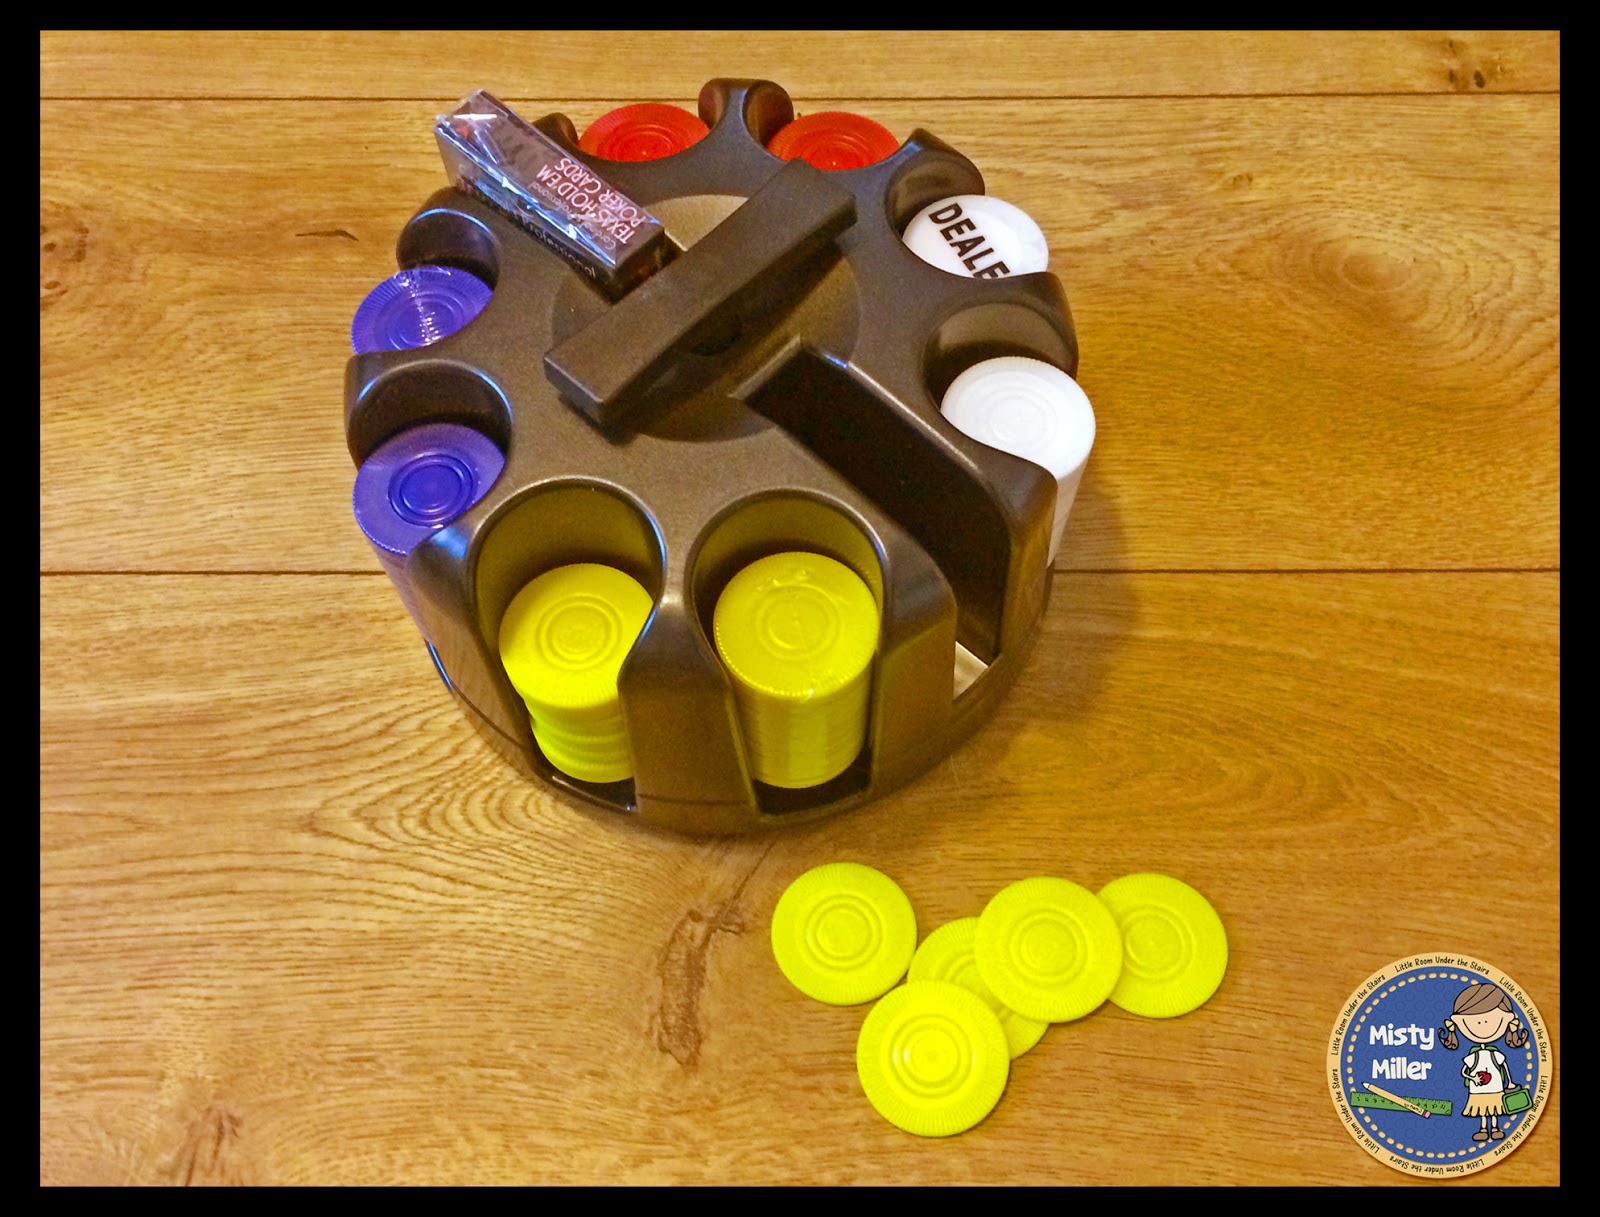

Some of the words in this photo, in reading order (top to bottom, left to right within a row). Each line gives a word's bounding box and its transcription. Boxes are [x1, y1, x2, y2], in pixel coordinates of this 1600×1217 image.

[536, 164, 599, 213] HOLD'EM
[554, 157, 602, 193] CARDS
[598, 188, 647, 228] POKER
[598, 208, 635, 244] TEXAS
[928, 202, 1011, 280] DEALE
